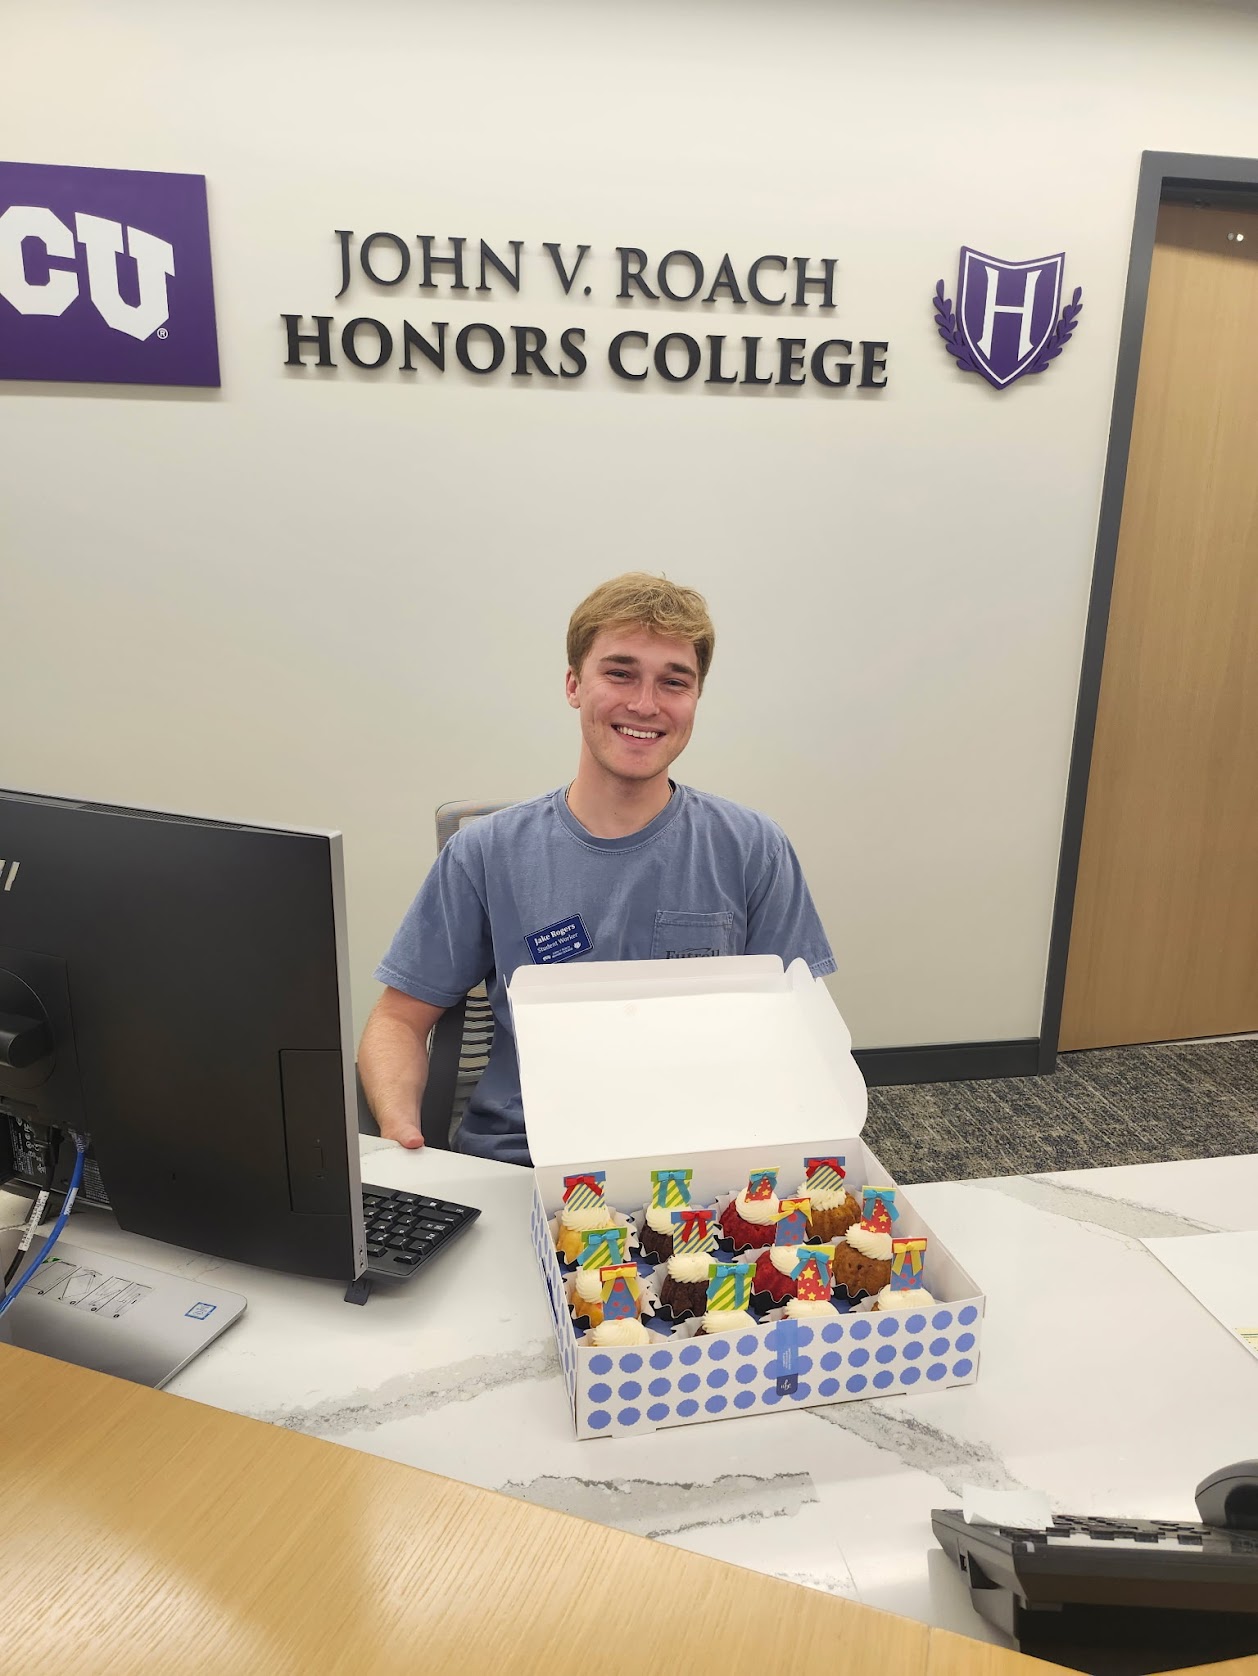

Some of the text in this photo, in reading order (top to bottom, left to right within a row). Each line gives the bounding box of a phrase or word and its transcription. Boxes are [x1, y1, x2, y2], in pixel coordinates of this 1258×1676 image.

[334, 229, 840, 309] JOHN V. ROACH
[279, 313, 890, 389] HONORS COLLEGE
[975, 265, 1044, 362] H
[534, 923, 576, 946] Jake Rogers
[537, 941, 558, 953] Student
[557, 932, 579, 944] Worker
